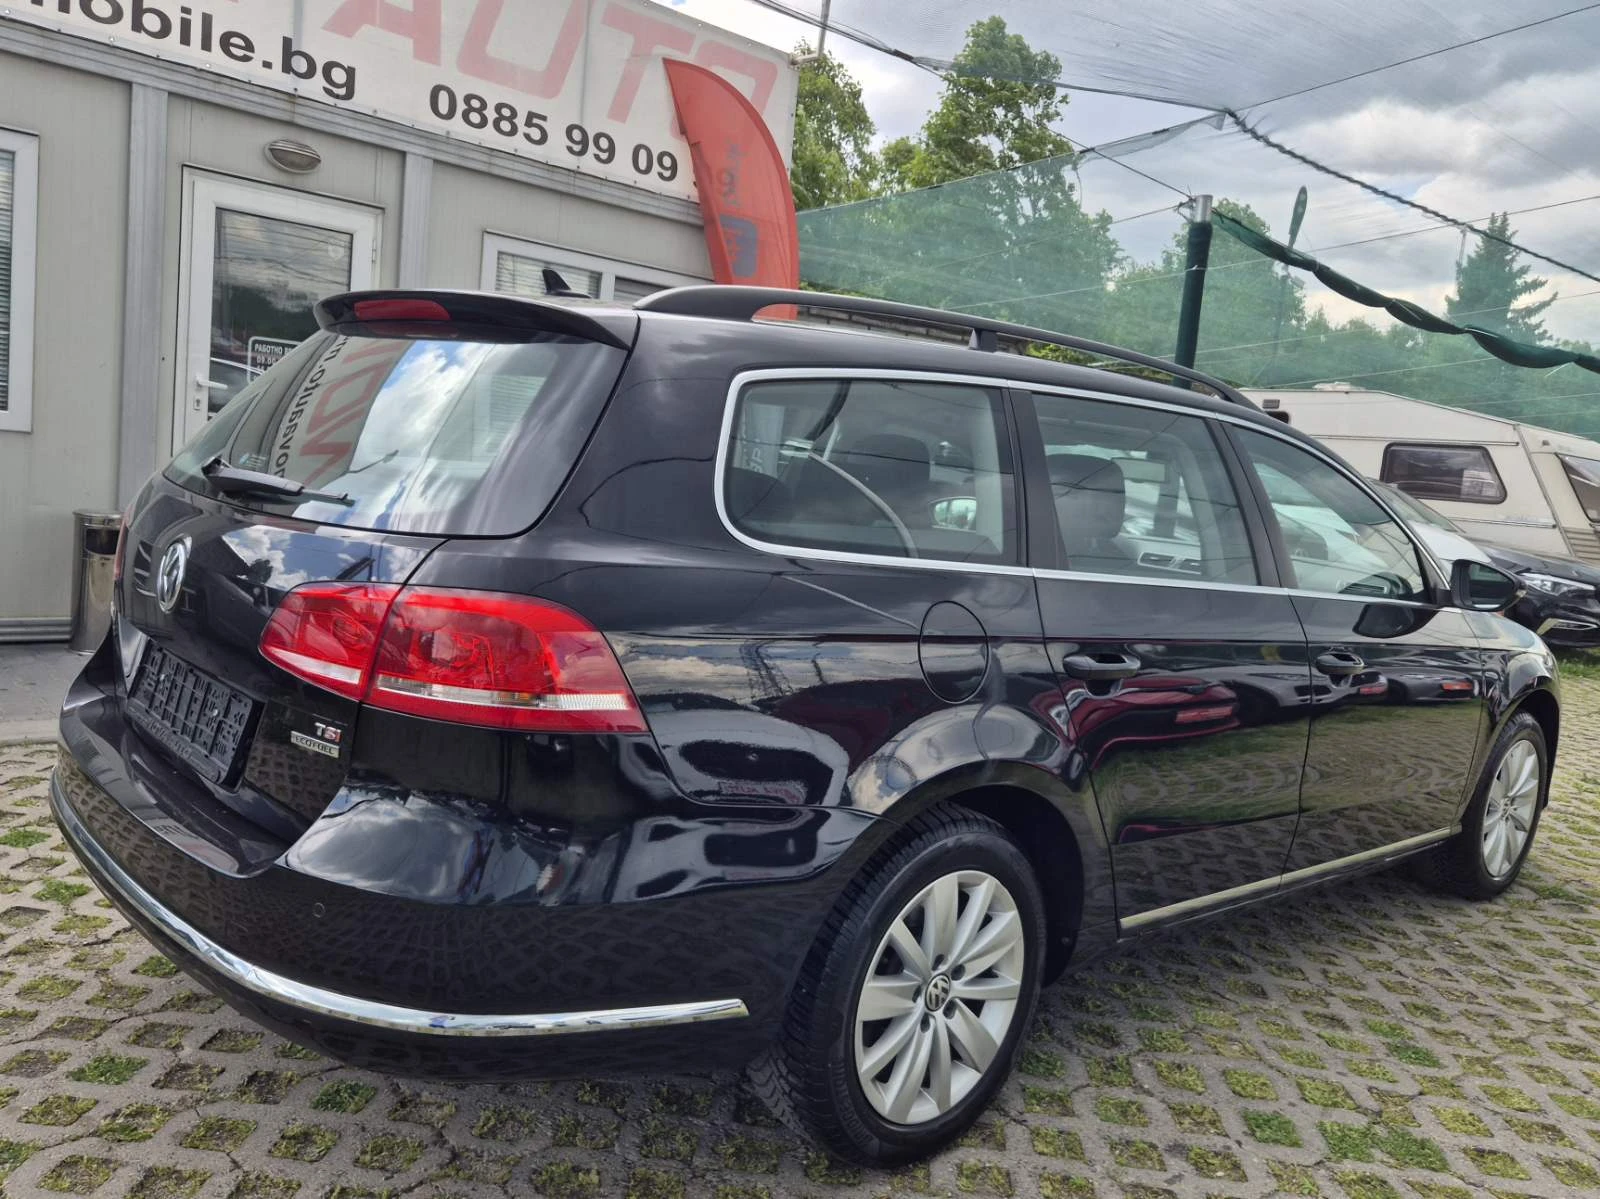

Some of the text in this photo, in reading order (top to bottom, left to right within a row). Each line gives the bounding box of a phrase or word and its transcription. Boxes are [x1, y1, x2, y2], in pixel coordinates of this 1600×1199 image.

[429, 83, 549, 146] 0885
[565, 123, 616, 165] 99
[632, 143, 678, 182] 09
